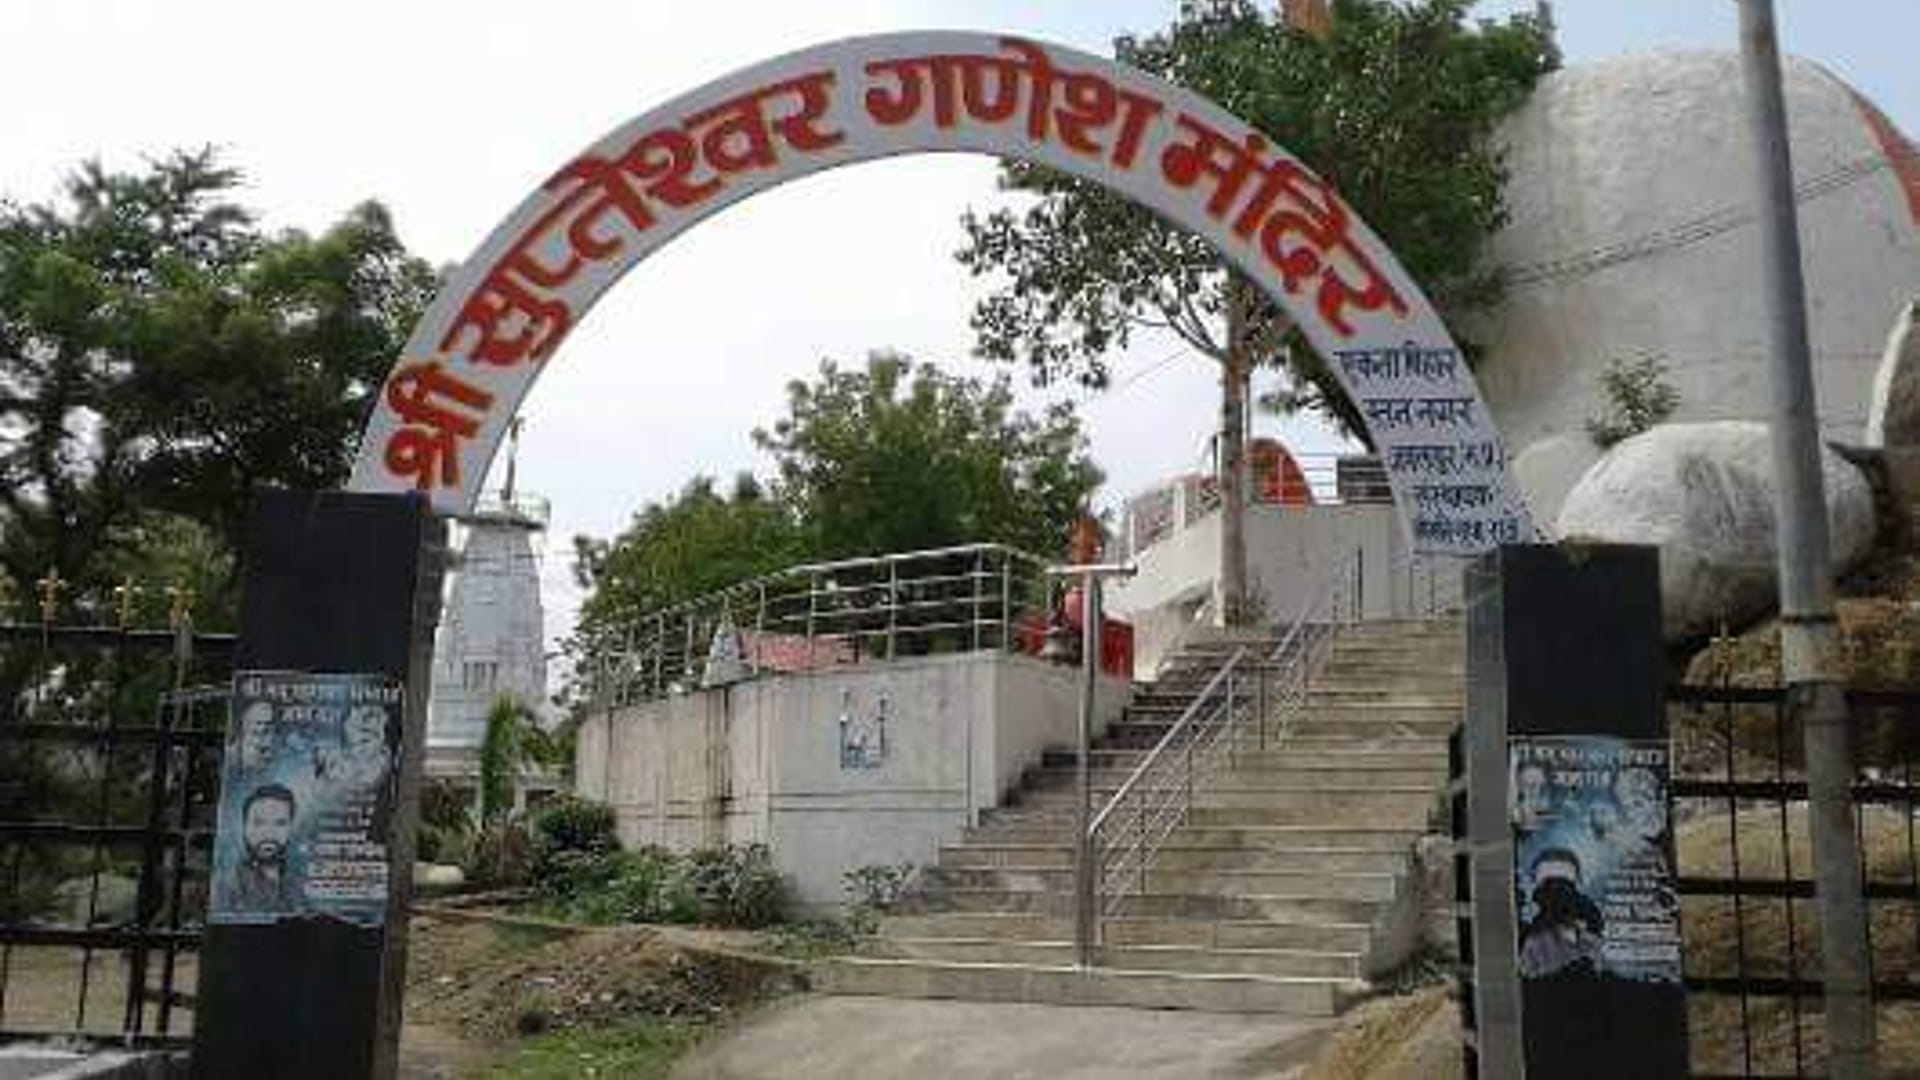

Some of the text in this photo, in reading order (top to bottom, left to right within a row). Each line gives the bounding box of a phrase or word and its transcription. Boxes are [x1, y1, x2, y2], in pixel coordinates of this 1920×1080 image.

[385, 36, 1408, 490] श्री सुप्तेश्वर गणेश मंदिर
